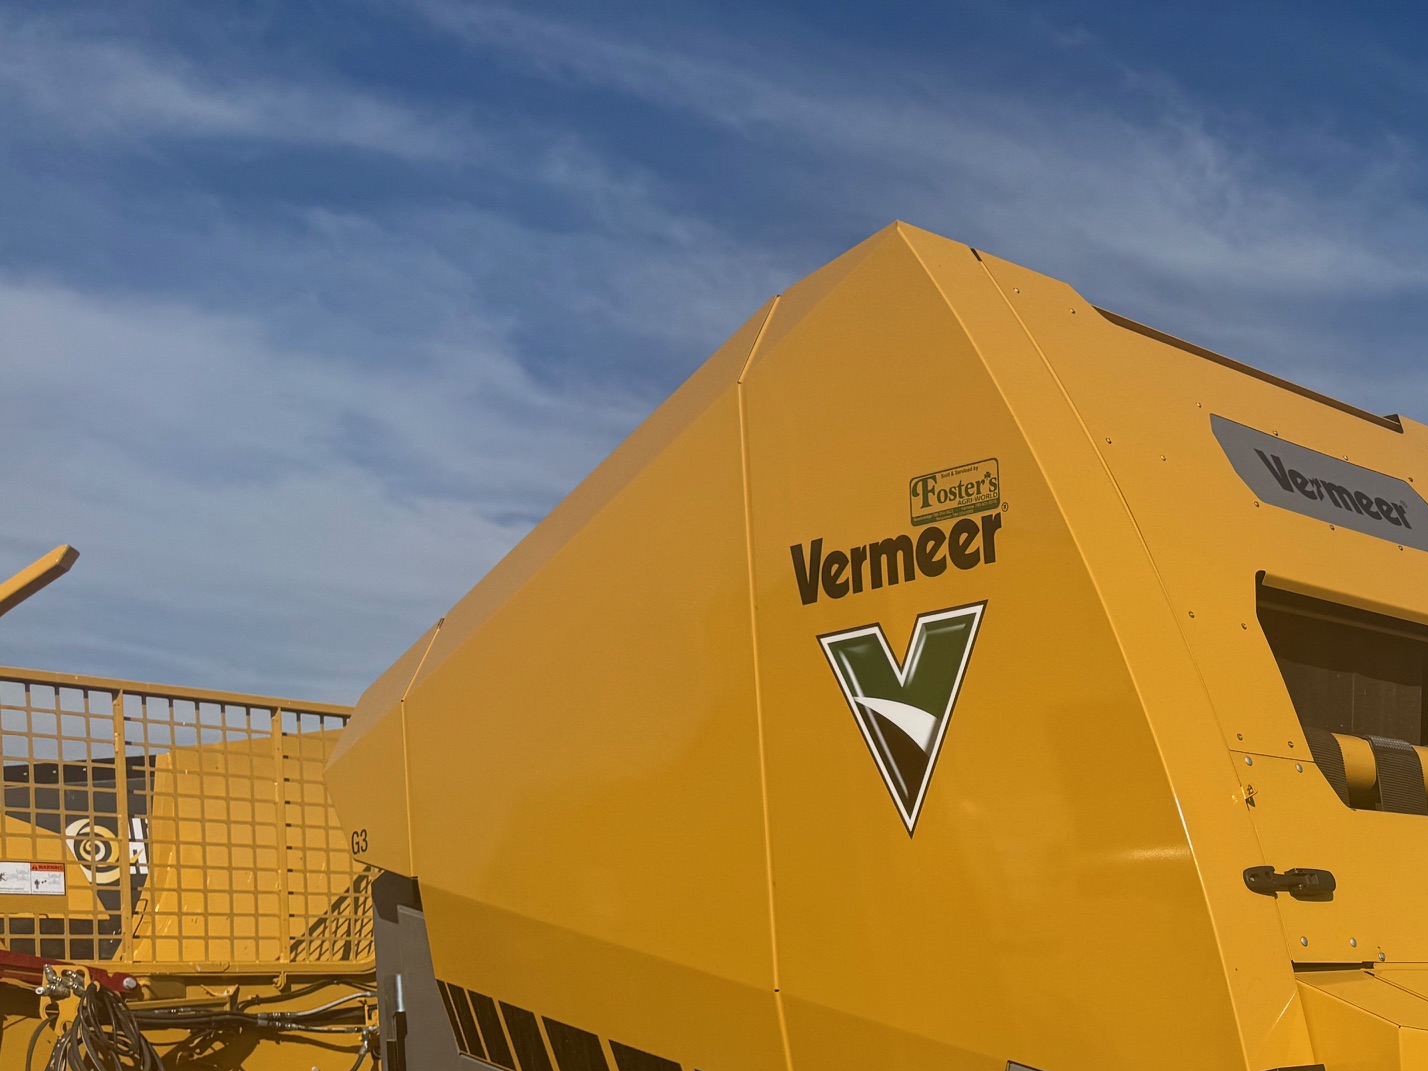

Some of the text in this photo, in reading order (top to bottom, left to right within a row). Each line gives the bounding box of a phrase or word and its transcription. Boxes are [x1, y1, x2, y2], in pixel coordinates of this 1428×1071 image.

[911, 473, 998, 509] Foster's
[957, 492, 998, 506] AGRI-WORLD
[1253, 448, 1412, 529] Vermeer
[790, 512, 1002, 606] Vermeer
[351, 829, 368, 855] G3
